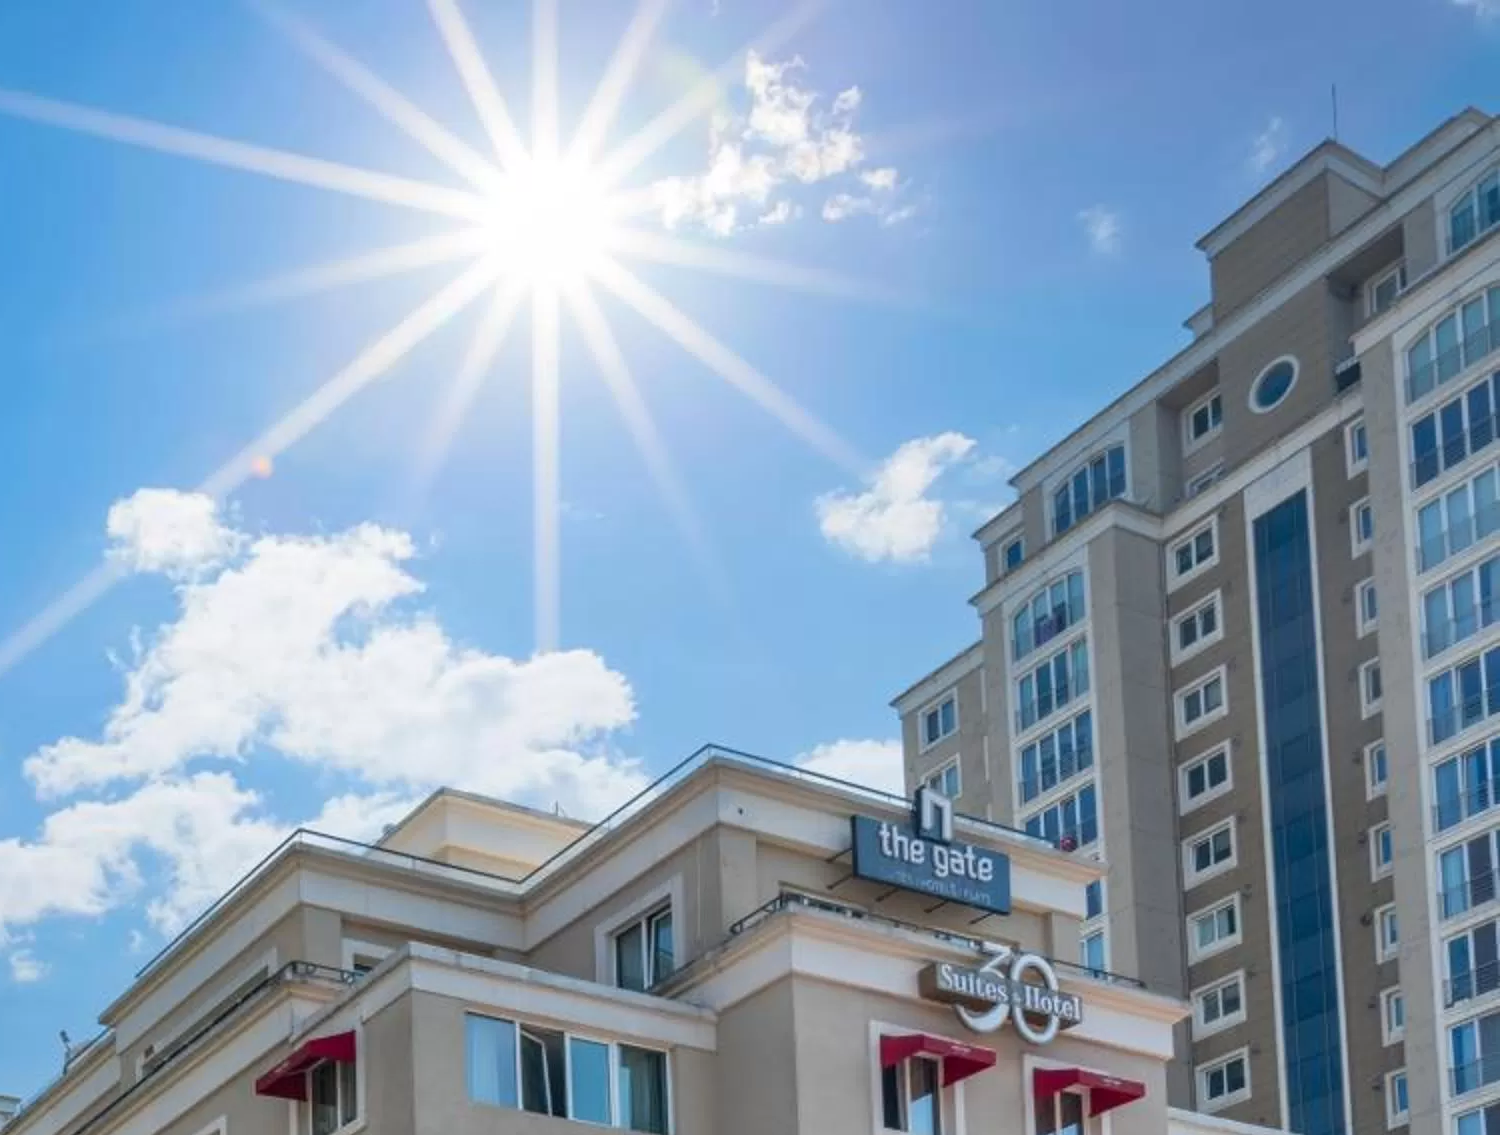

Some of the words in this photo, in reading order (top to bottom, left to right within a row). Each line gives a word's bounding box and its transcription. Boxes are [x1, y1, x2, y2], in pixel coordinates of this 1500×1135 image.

[878, 823, 925, 864] the
[933, 846, 993, 881] gate
[940, 963, 1008, 1003] Suites
[1023, 985, 1081, 1021] Hotel
